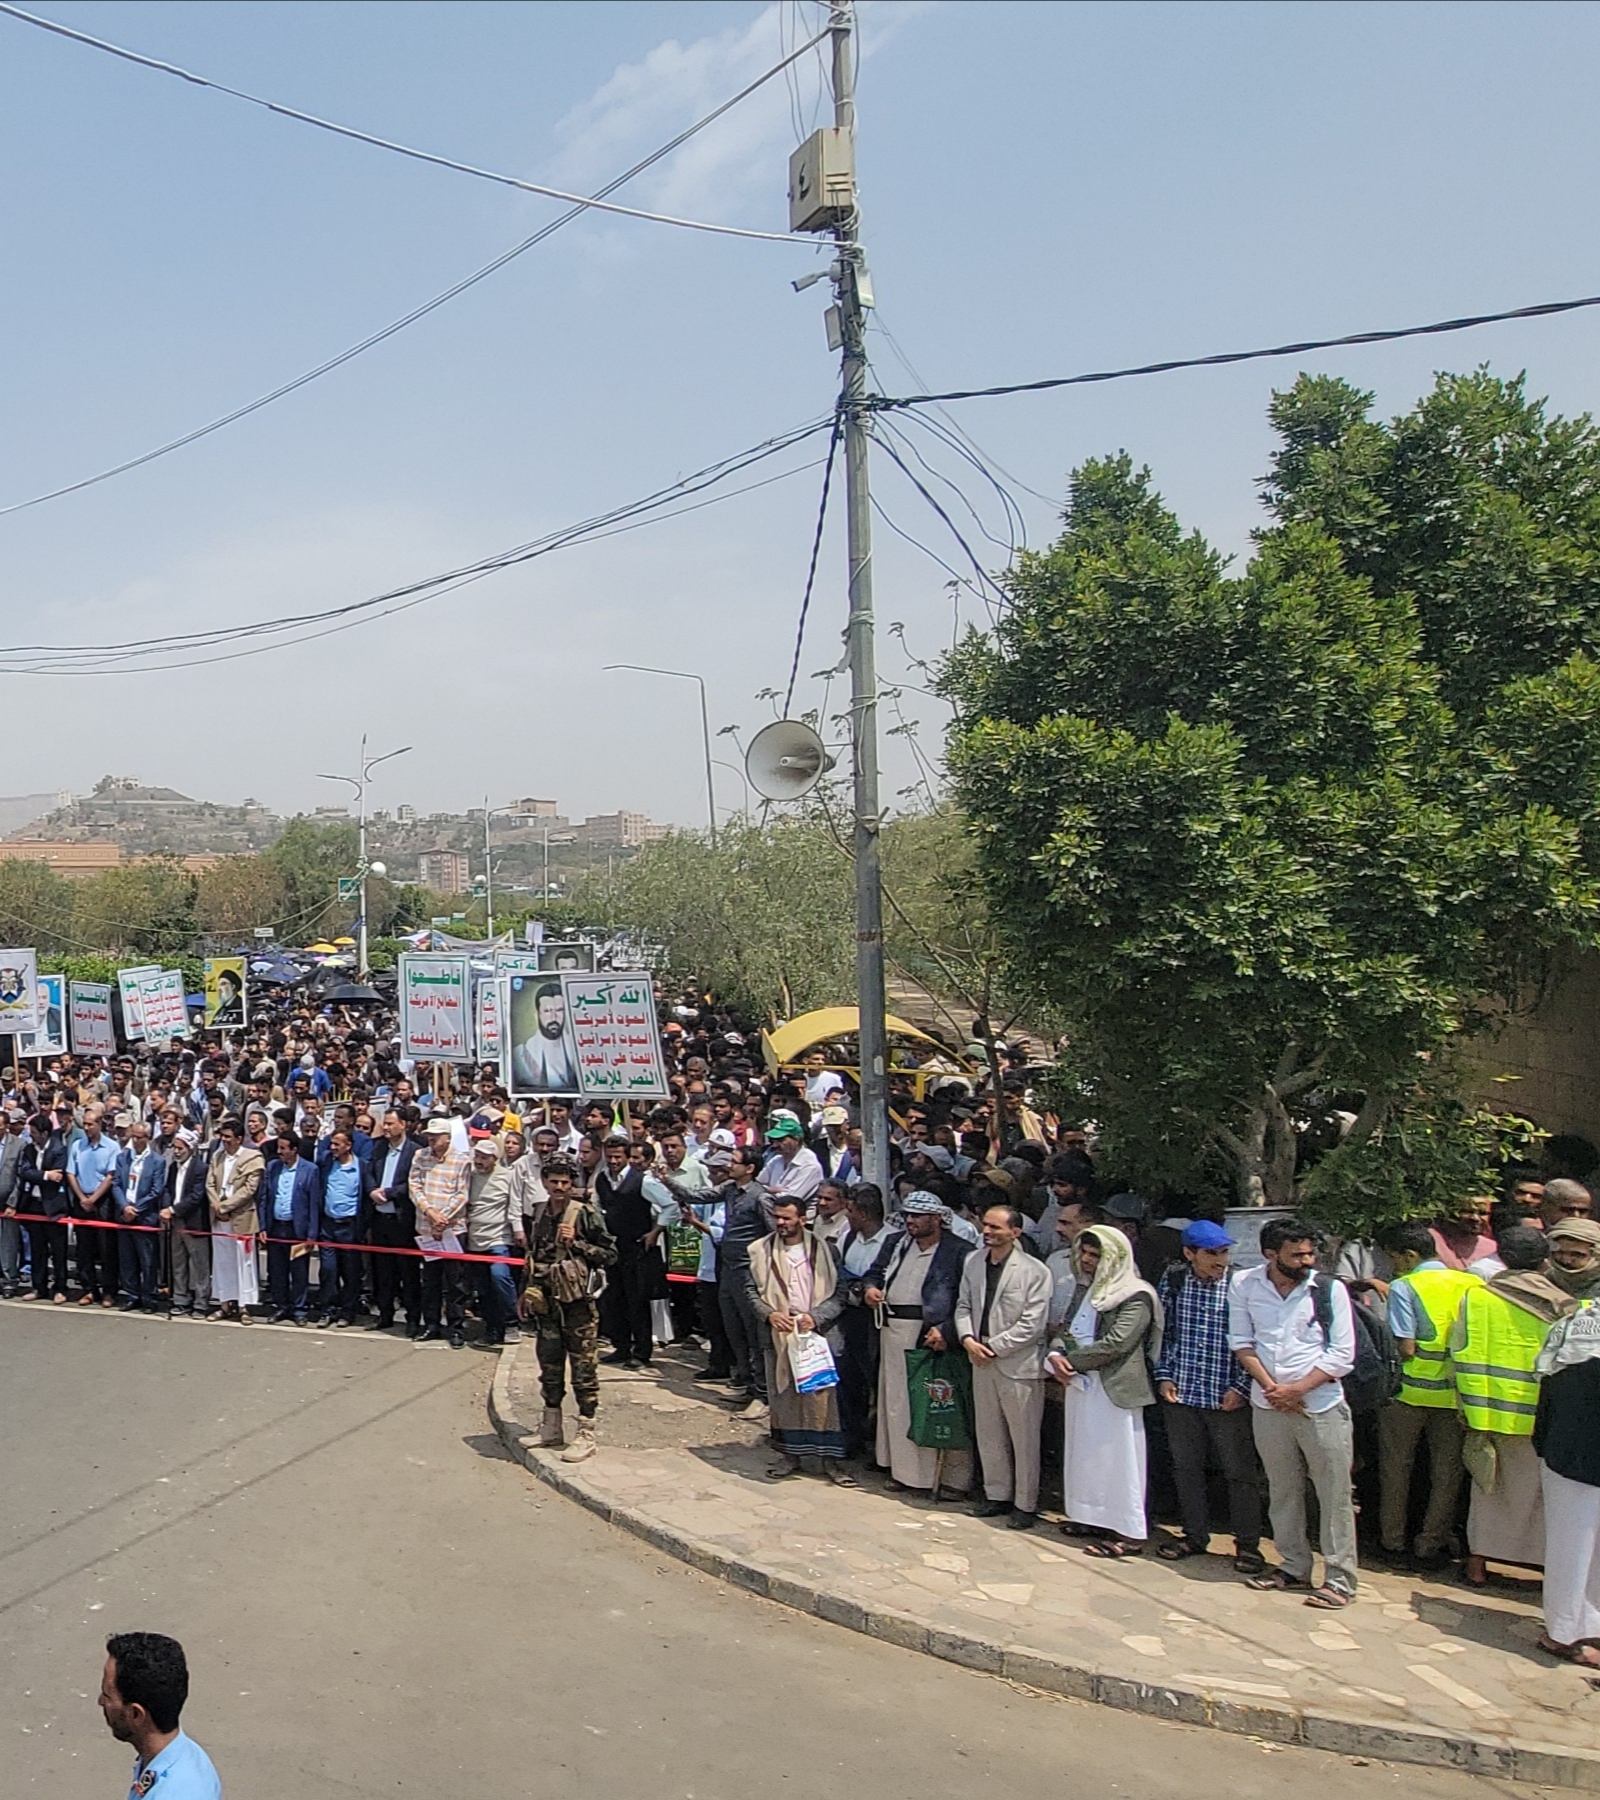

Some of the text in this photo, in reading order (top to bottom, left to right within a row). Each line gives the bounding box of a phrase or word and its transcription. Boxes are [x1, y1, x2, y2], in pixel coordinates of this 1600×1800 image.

[408, 968, 460, 987] قاطعوا
[572, 983, 647, 1011] الله أكبر
[574, 1010, 649, 1027] الموت لأمريكا
[578, 1031, 651, 1047] الموت لإسرائيل
[581, 1052, 654, 1066] اللعنة على اليهود
[585, 1069, 659, 1090] النصر للإسلام
